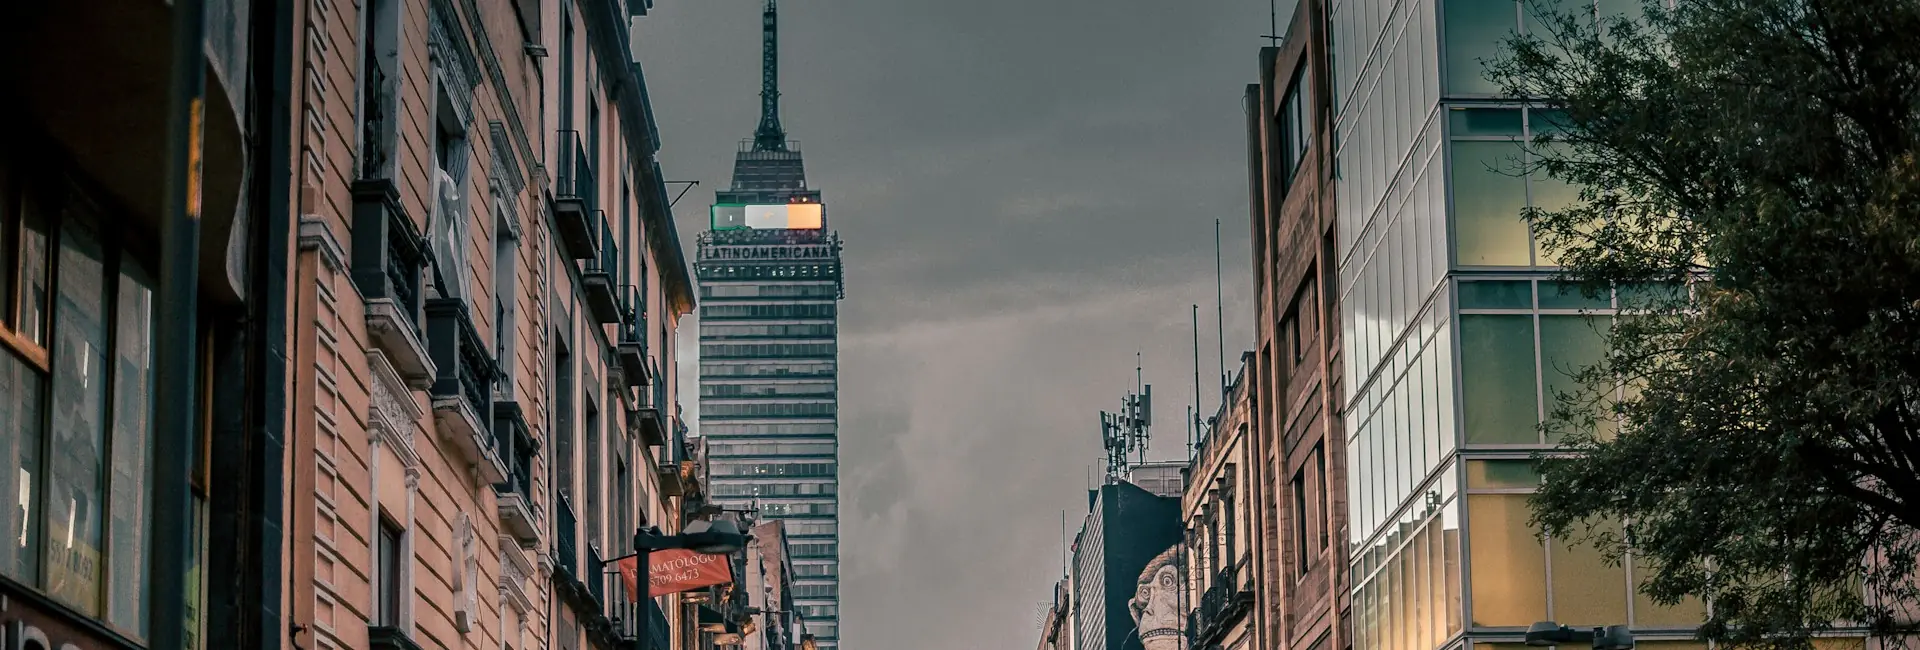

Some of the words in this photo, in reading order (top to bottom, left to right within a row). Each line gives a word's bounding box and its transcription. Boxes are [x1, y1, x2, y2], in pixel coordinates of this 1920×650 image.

[705, 246, 827, 259] LATINOAMERICANA
[630, 553, 716, 578] DMATÓLOGO
[649, 572, 672, 587] 5709
[675, 568, 699, 582] 6473
